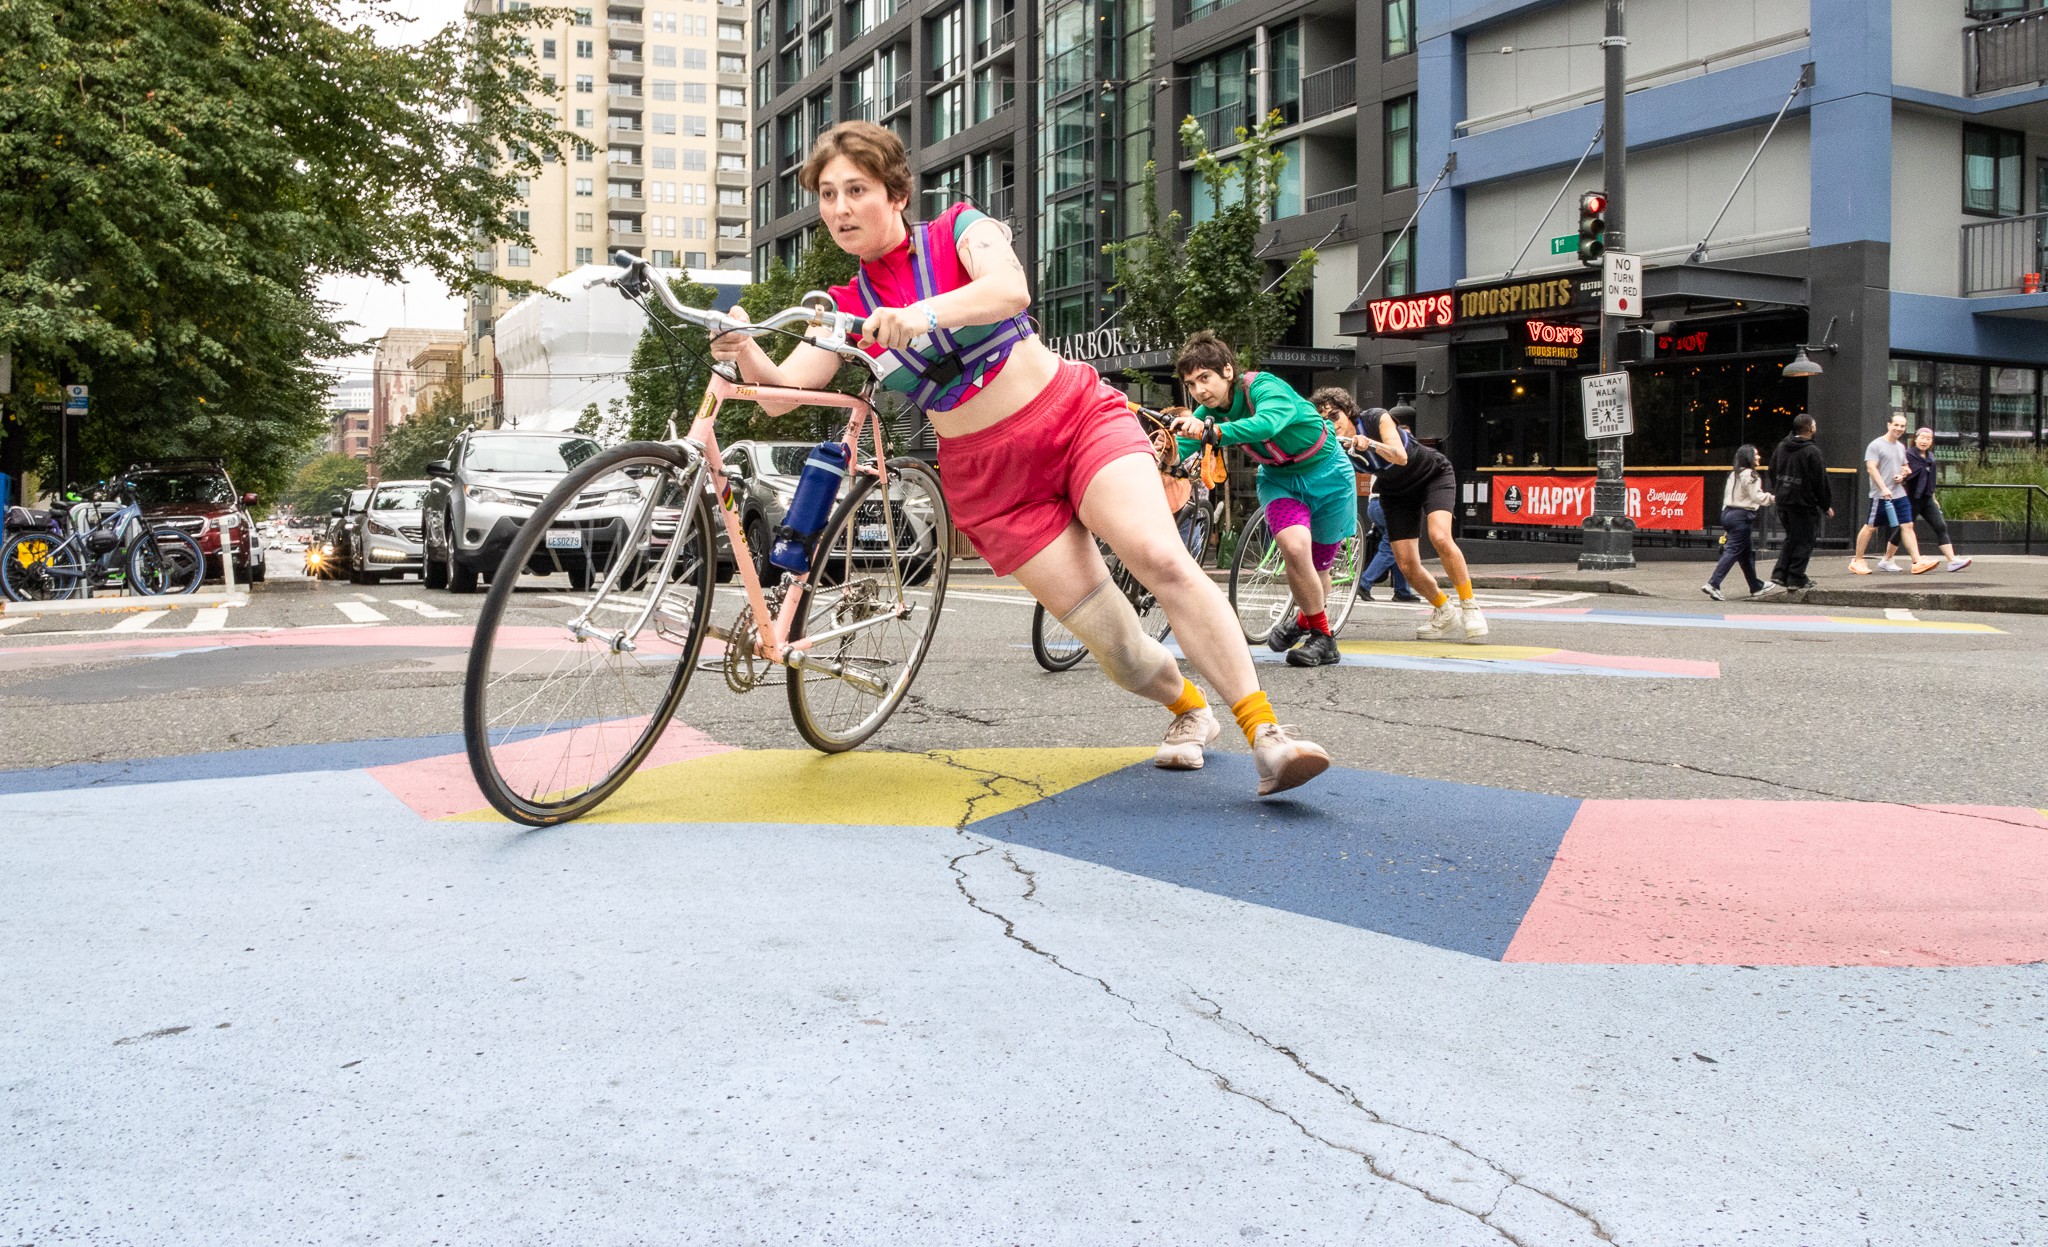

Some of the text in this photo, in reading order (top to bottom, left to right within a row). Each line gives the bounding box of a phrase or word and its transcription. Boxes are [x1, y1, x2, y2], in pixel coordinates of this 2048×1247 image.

[1555, 239, 1564, 252] 1st
[1615, 259, 1631, 271] NO
[1613, 273, 1634, 283] TURN
[1608, 285, 1619, 295] ON
[1623, 286, 1638, 297] RED
[1461, 279, 1571, 318] 1000SPIRITS
[1369, 294, 1452, 333] VON'S
[1526, 321, 1584, 344] VON'S
[1049, 328, 1126, 361] HARBOR
[1268, 351, 1340, 363] ARBOR STEPS
[1526, 345, 1579, 359] 1000SPIRITS
[1588, 377, 1623, 388] ALL WAY
[1596, 387, 1617, 397] WALK
[1527, 486, 1585, 516] HAPPY
[1647, 488, 1688, 506] Everyday
[1650, 506, 1684, 518] 2-6pm
